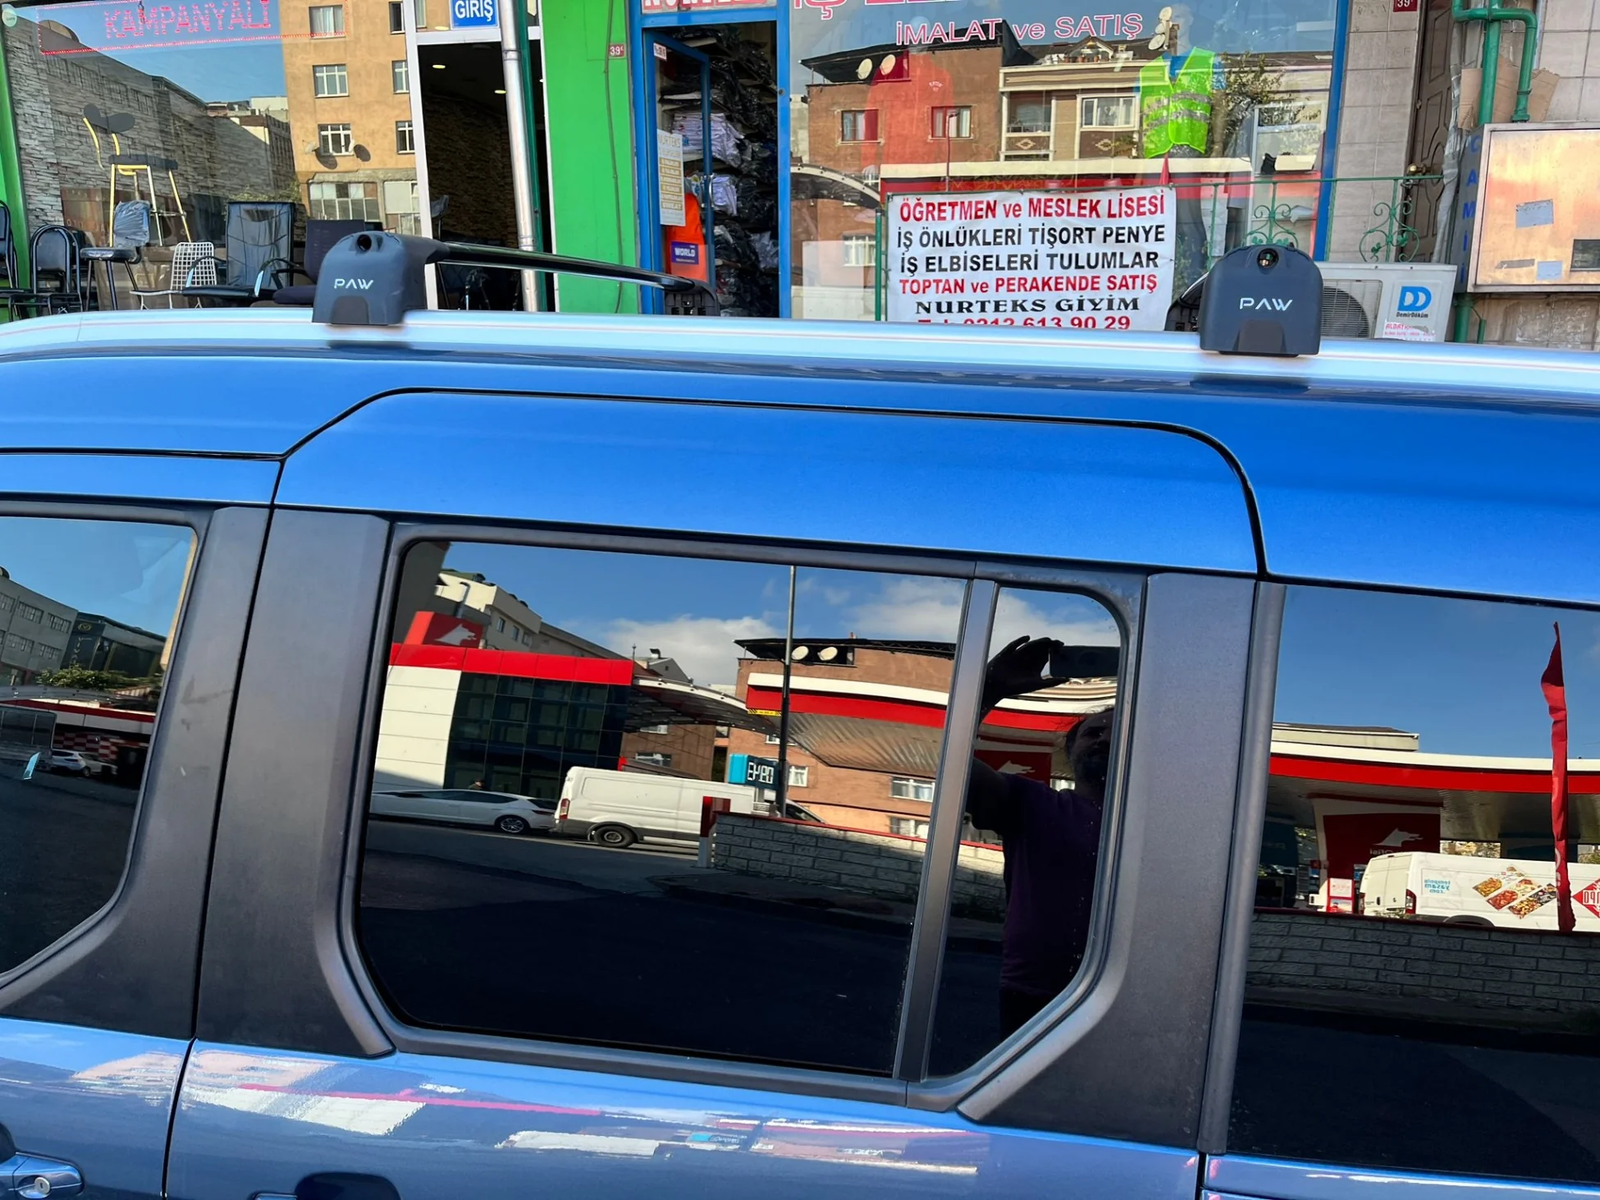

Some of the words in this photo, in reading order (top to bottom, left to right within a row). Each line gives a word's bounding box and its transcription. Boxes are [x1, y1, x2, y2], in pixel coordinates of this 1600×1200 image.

[896, 20, 1002, 45] İMALAT
[1012, 23, 1045, 40] ve
[1054, 13, 1143, 40] SATIŞ
[900, 198, 997, 222] ÖĞRETMEN
[1003, 202, 1022, 218] ve
[1028, 197, 1101, 218] MESLEK
[1107, 189, 1164, 218] LİSESİ
[898, 226, 913, 252] İŞ
[919, 223, 1021, 248] ÖNLÜKLERİ
[1028, 223, 1096, 249] TİŞORT
[1102, 224, 1165, 244] PENYE
[901, 252, 918, 277] İŞ
[925, 249, 1038, 272] ELBİSELERİ
[1046, 252, 1159, 270] TULUMLAR
[333, 278, 374, 289] PAW
[899, 278, 965, 294] TOPTAN
[971, 281, 989, 293] ve
[995, 275, 1100, 292] PERAKENDE
[1106, 274, 1157, 294] SATIŞ
[915, 299, 1046, 314] NURTEKS
[1055, 294, 1140, 312] GİYİM
[1239, 297, 1293, 311] PAW
[1104, 315, 1130, 330] 29
